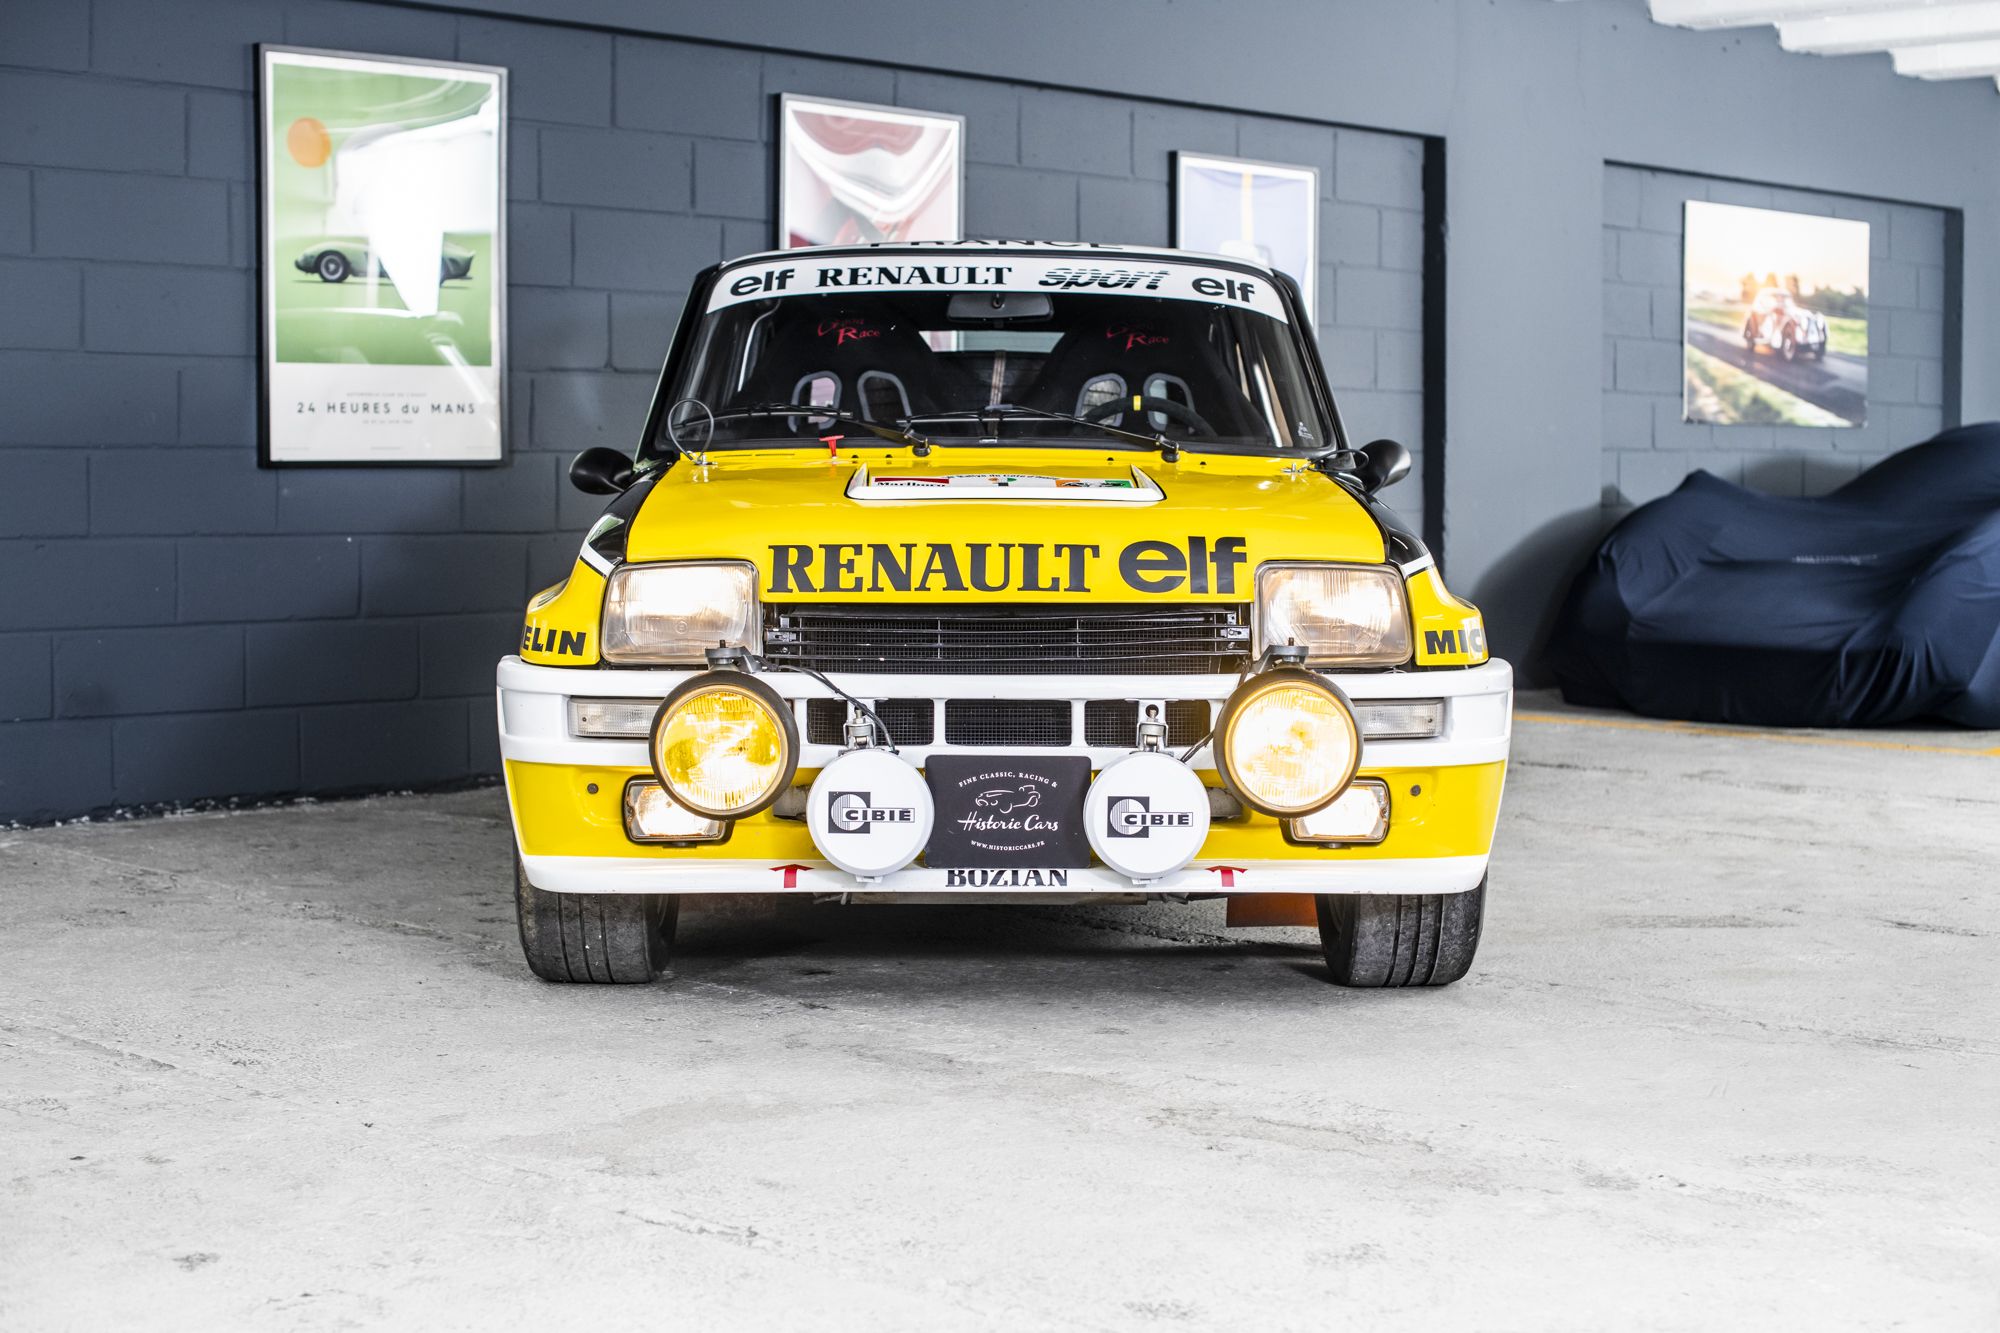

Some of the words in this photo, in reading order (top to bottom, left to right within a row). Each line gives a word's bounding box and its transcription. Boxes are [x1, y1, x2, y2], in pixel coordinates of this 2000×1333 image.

[730, 268, 795, 296] elf
[816, 266, 1012, 288] RENAULT
[1038, 267, 1171, 291] sport
[1191, 277, 1255, 302] elf
[297, 402, 316, 414] 24
[326, 402, 391, 414] HEURES
[401, 402, 420, 414] du
[430, 402, 476, 414] MANS
[767, 543, 1100, 593] RENAULT
[1119, 536, 1247, 595] elf
[958, 776, 978, 788] FINE
[1018, 772, 1050, 785] RACING
[957, 811, 1021, 832] Historic
[1024, 814, 1059, 832] Cars
